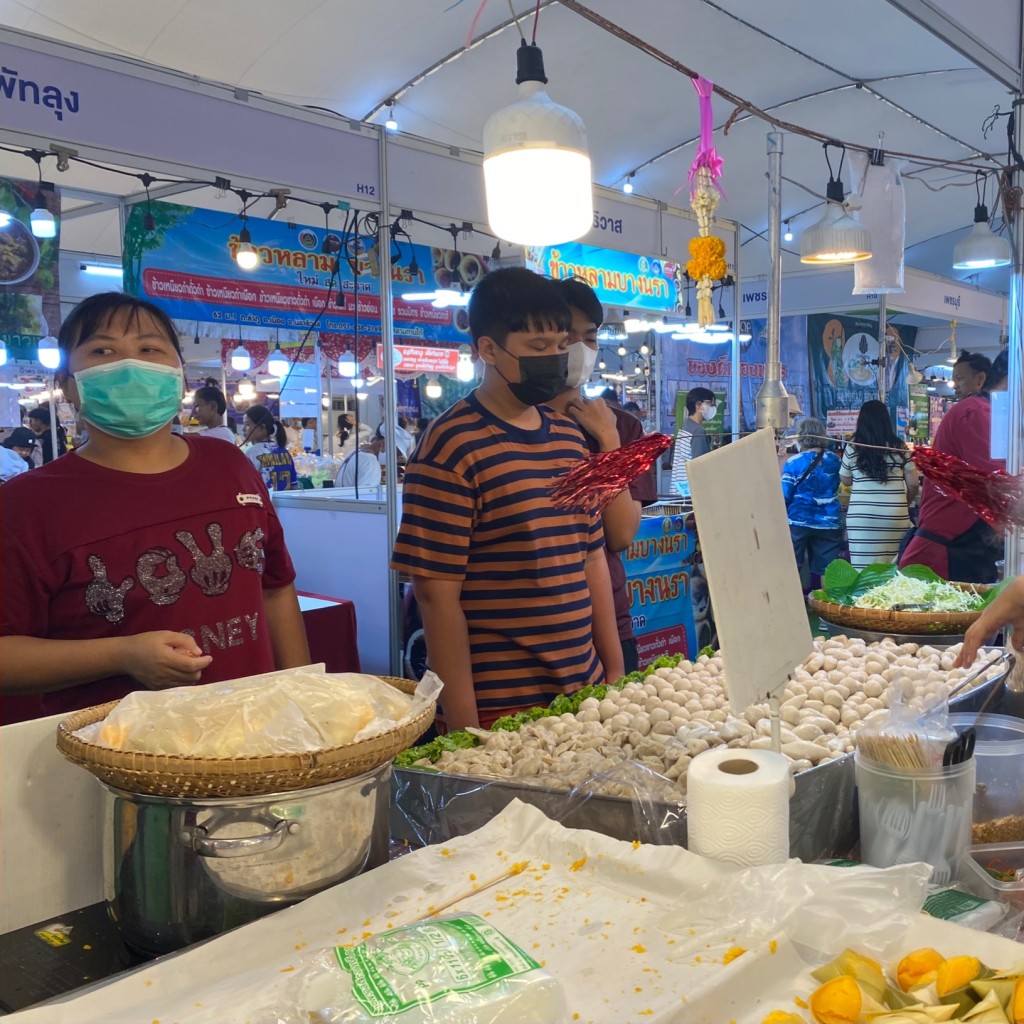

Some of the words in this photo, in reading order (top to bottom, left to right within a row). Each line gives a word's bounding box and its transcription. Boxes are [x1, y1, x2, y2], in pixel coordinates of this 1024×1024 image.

[0, 66, 80, 121] พัทลุง
[357, 183, 376, 196] H12
